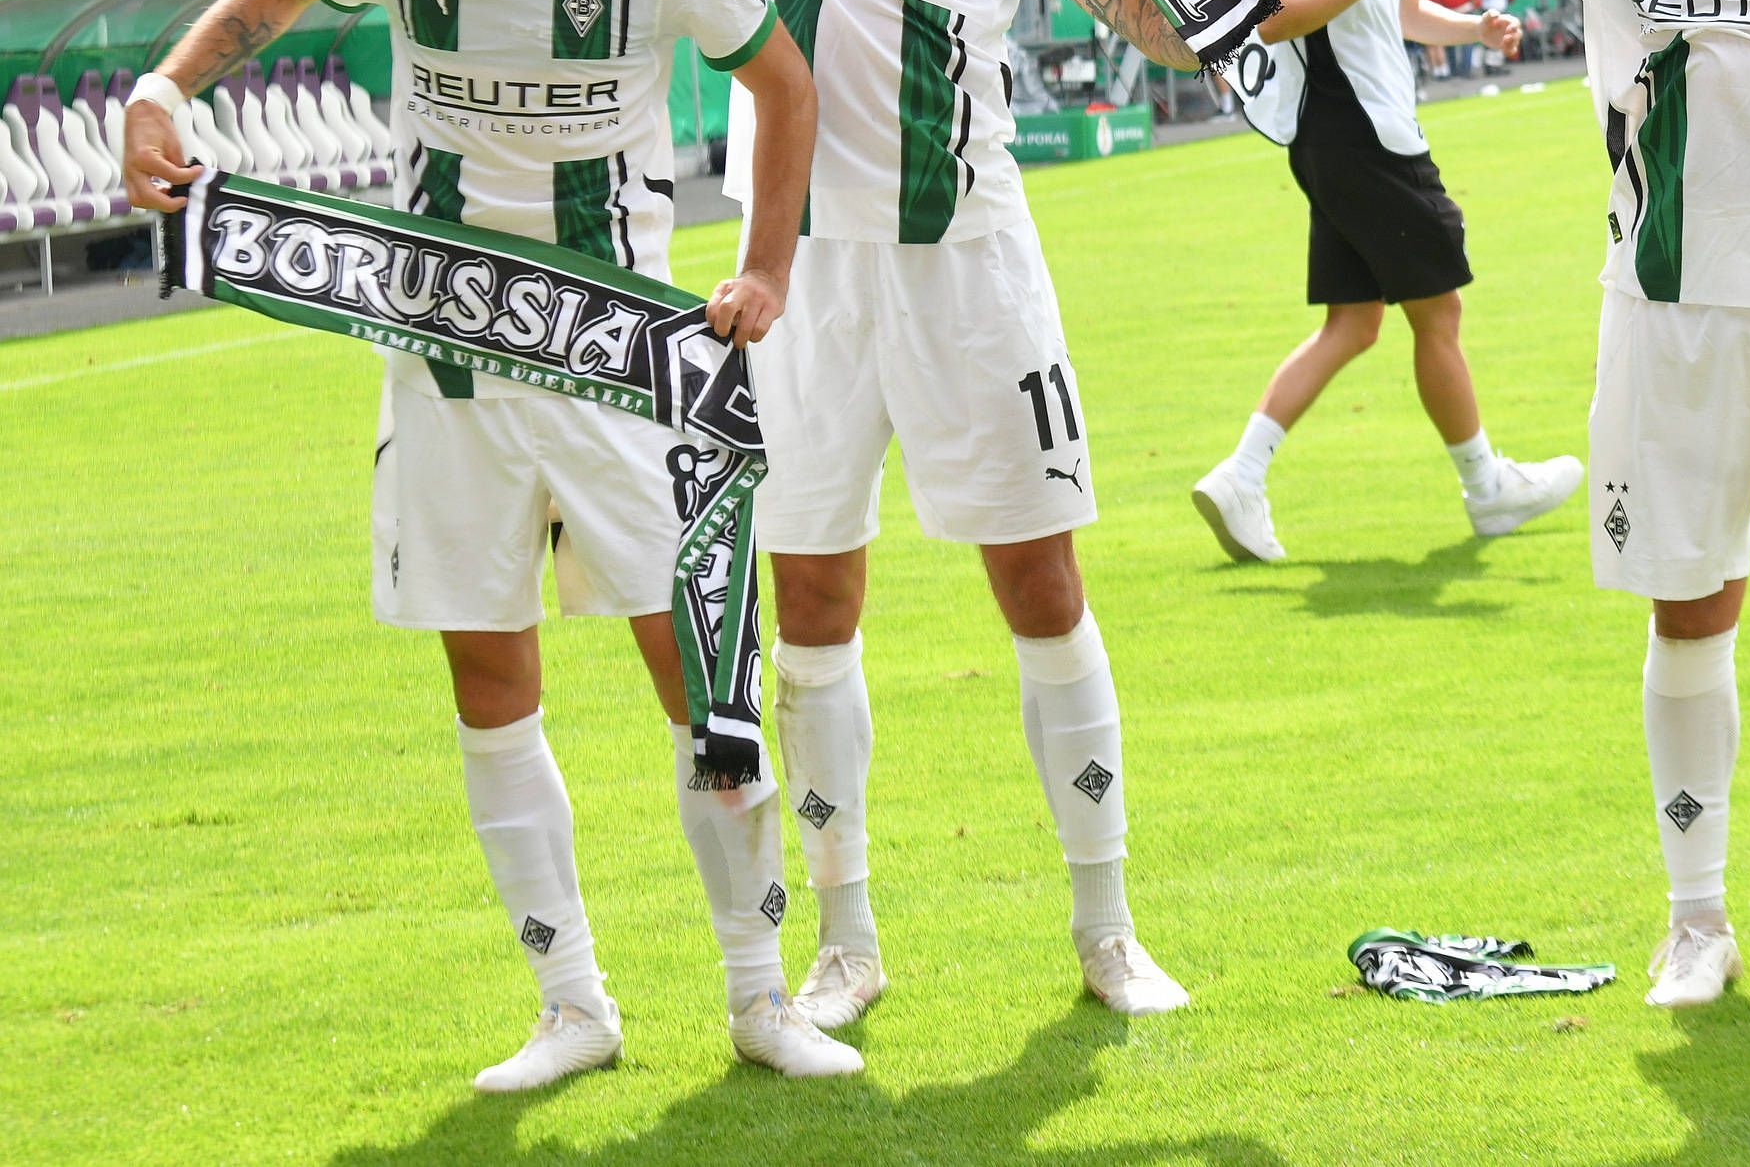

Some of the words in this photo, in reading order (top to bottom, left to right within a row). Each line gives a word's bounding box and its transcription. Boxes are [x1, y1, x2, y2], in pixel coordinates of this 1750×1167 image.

[406, 99, 471, 129] BÄDER
[489, 116, 621, 135] LEUCHTEN
[411, 63, 620, 109] REUTER
[207, 202, 651, 378] BORUSSIA
[349, 322, 445, 360] IMMER
[452, 347, 503, 377] UND
[509, 361, 645, 415] ÜBERALL!
[1017, 362, 1081, 452] 11
